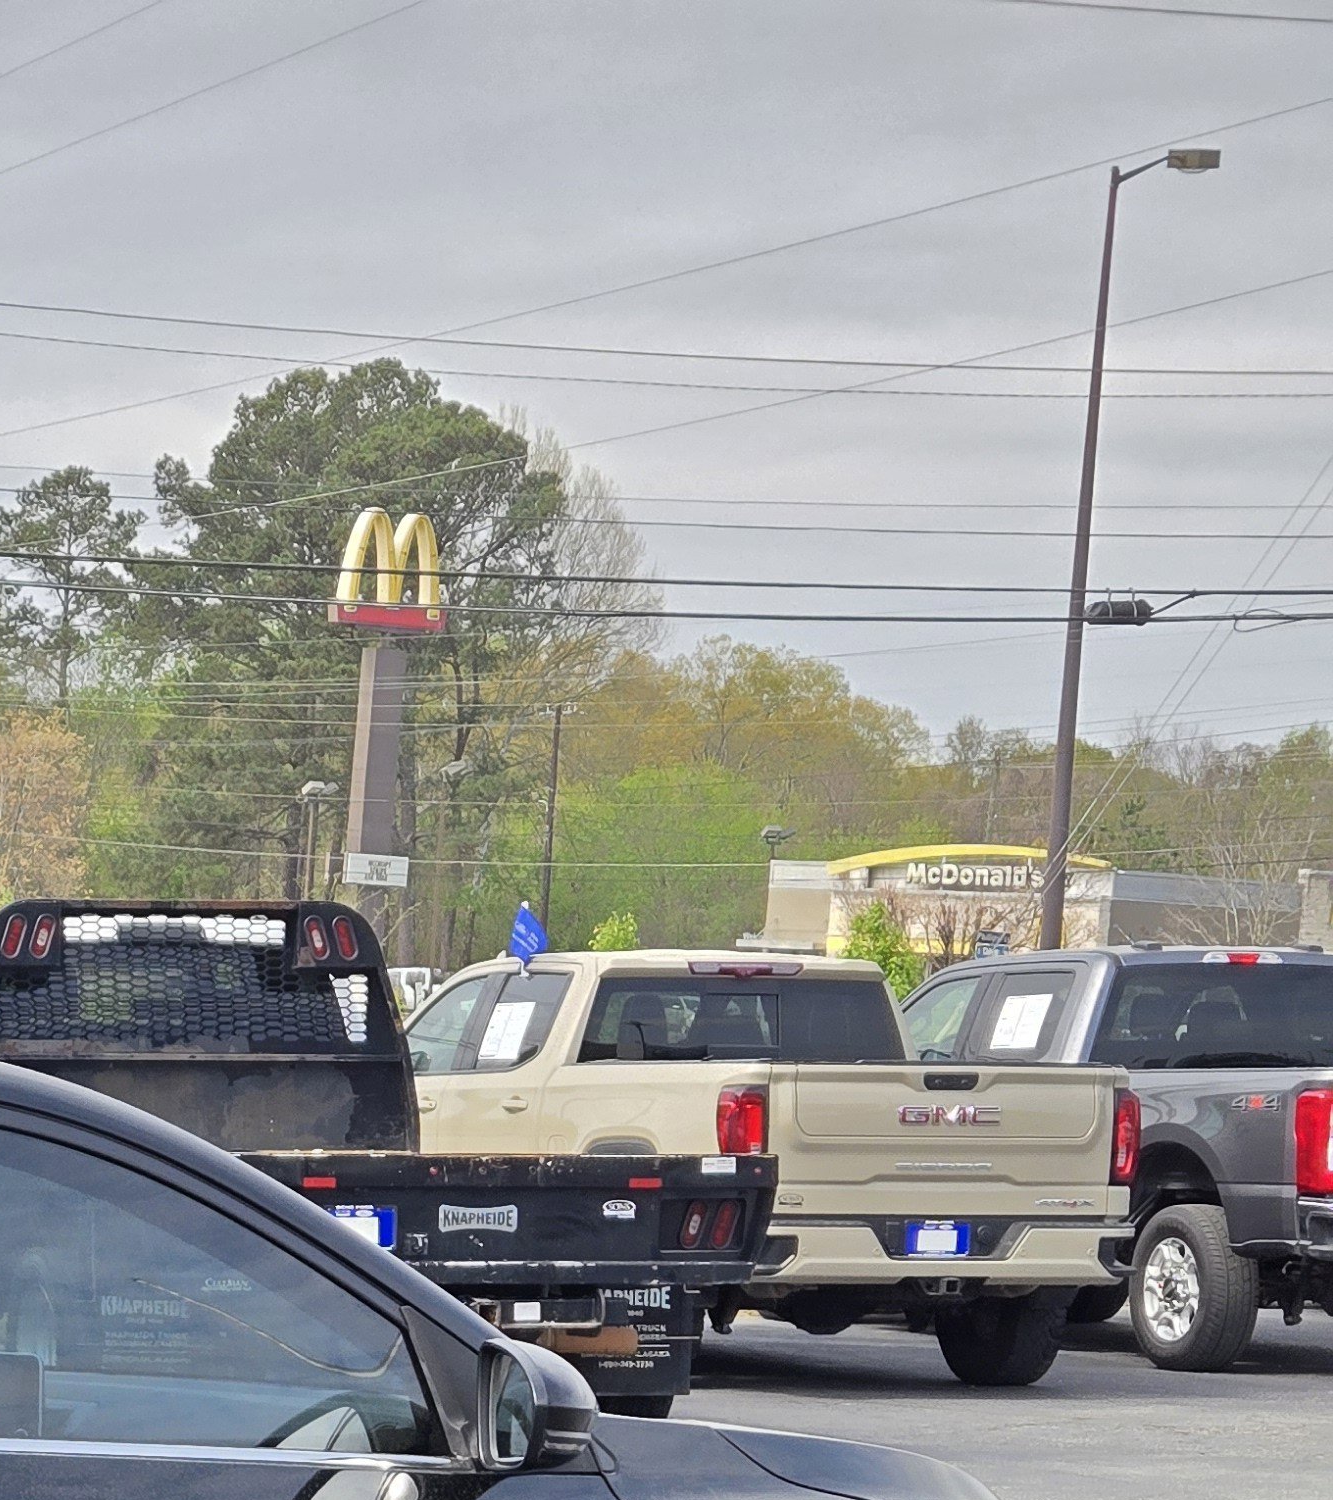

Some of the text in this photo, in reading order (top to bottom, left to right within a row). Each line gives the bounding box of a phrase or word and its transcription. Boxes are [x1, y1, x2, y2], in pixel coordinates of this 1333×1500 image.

[906, 859, 1045, 889] McDonald's
[897, 1104, 1001, 1126] GMC
[443, 1208, 514, 1228] KNAPHEIDE
[599, 1285, 671, 1309] APHEIDE
